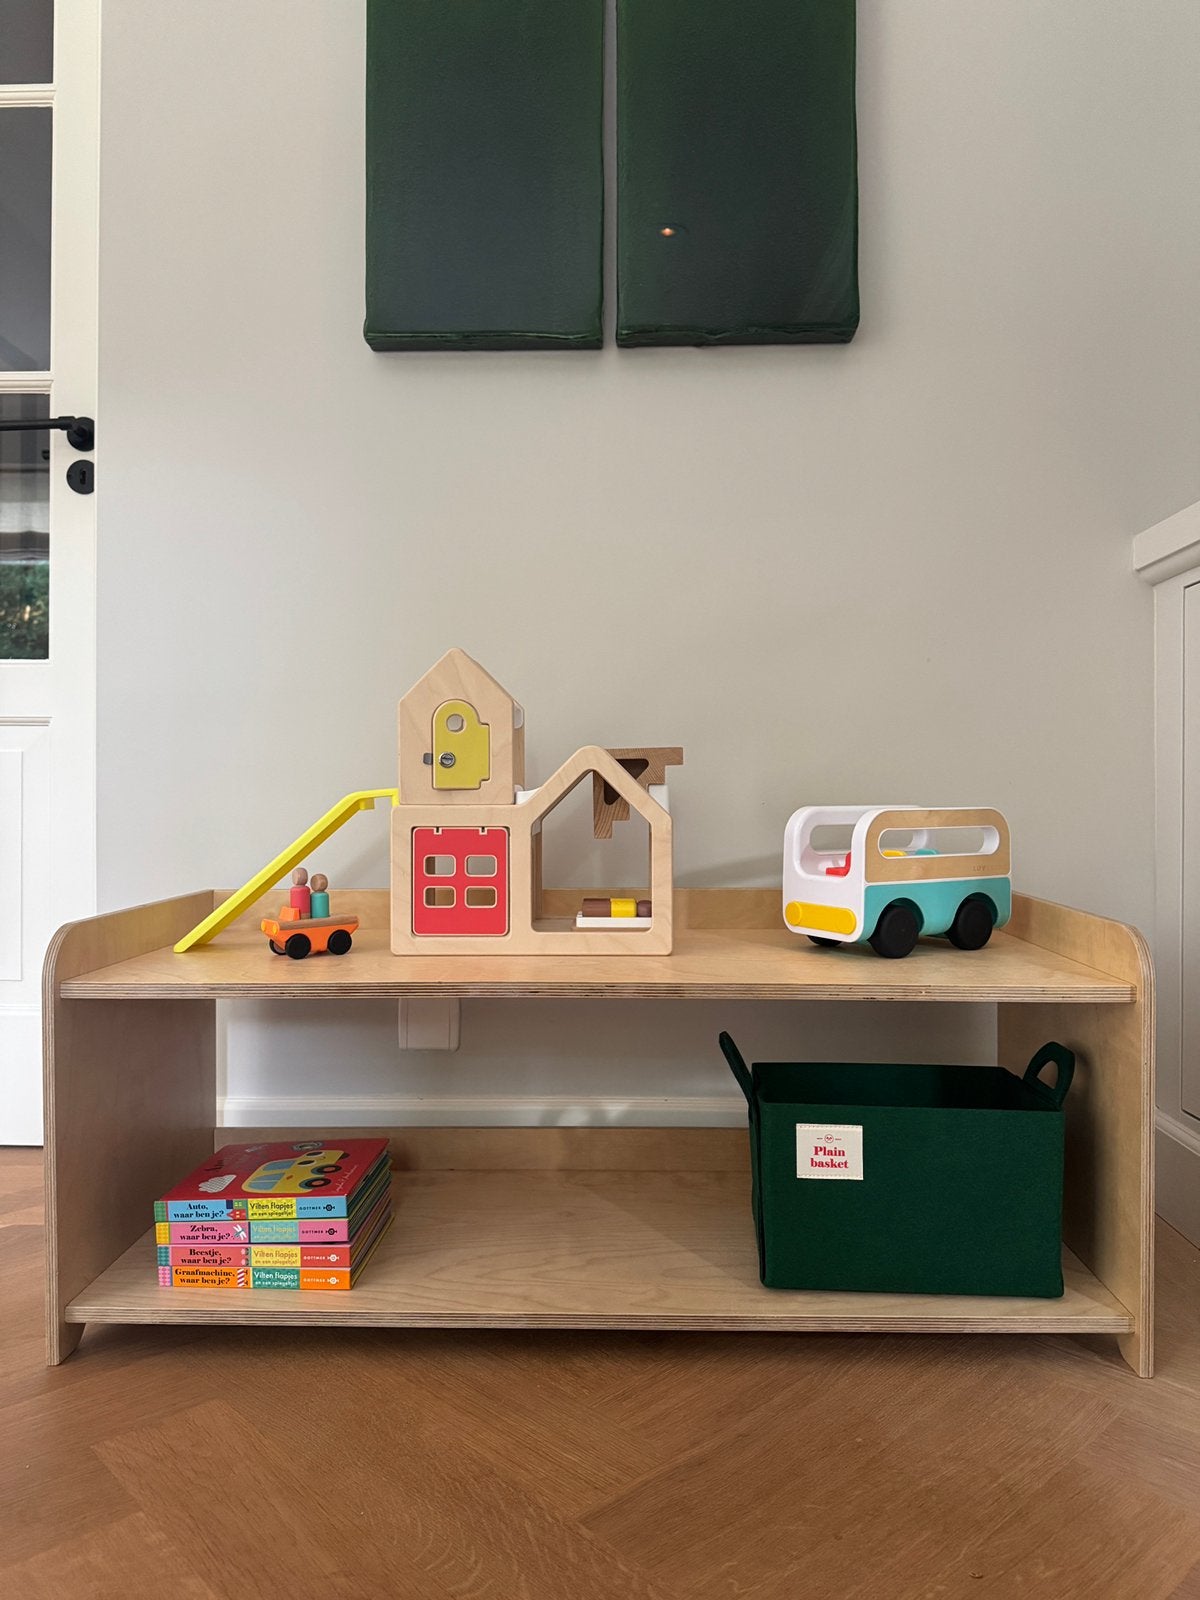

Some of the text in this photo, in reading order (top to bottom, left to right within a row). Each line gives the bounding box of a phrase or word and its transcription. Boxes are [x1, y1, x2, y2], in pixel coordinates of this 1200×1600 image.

[814, 1146, 845, 1156] Plain
[810, 1158, 848, 1168] basket
[250, 1202, 293, 1210] Vilten flapjes
[210, 1210, 224, 1219] je?
[190, 1224, 218, 1232] Zebra,
[217, 1232, 230, 1241] je?
[189, 1248, 221, 1257] Beestje,
[254, 1250, 298, 1259] Vilten flapjes
[218, 1257, 231, 1265] je?
[175, 1268, 235, 1277] Graafmachine,
[254, 1271, 298, 1280] Vilten flapjes
[217, 1277, 230, 1285] je?
